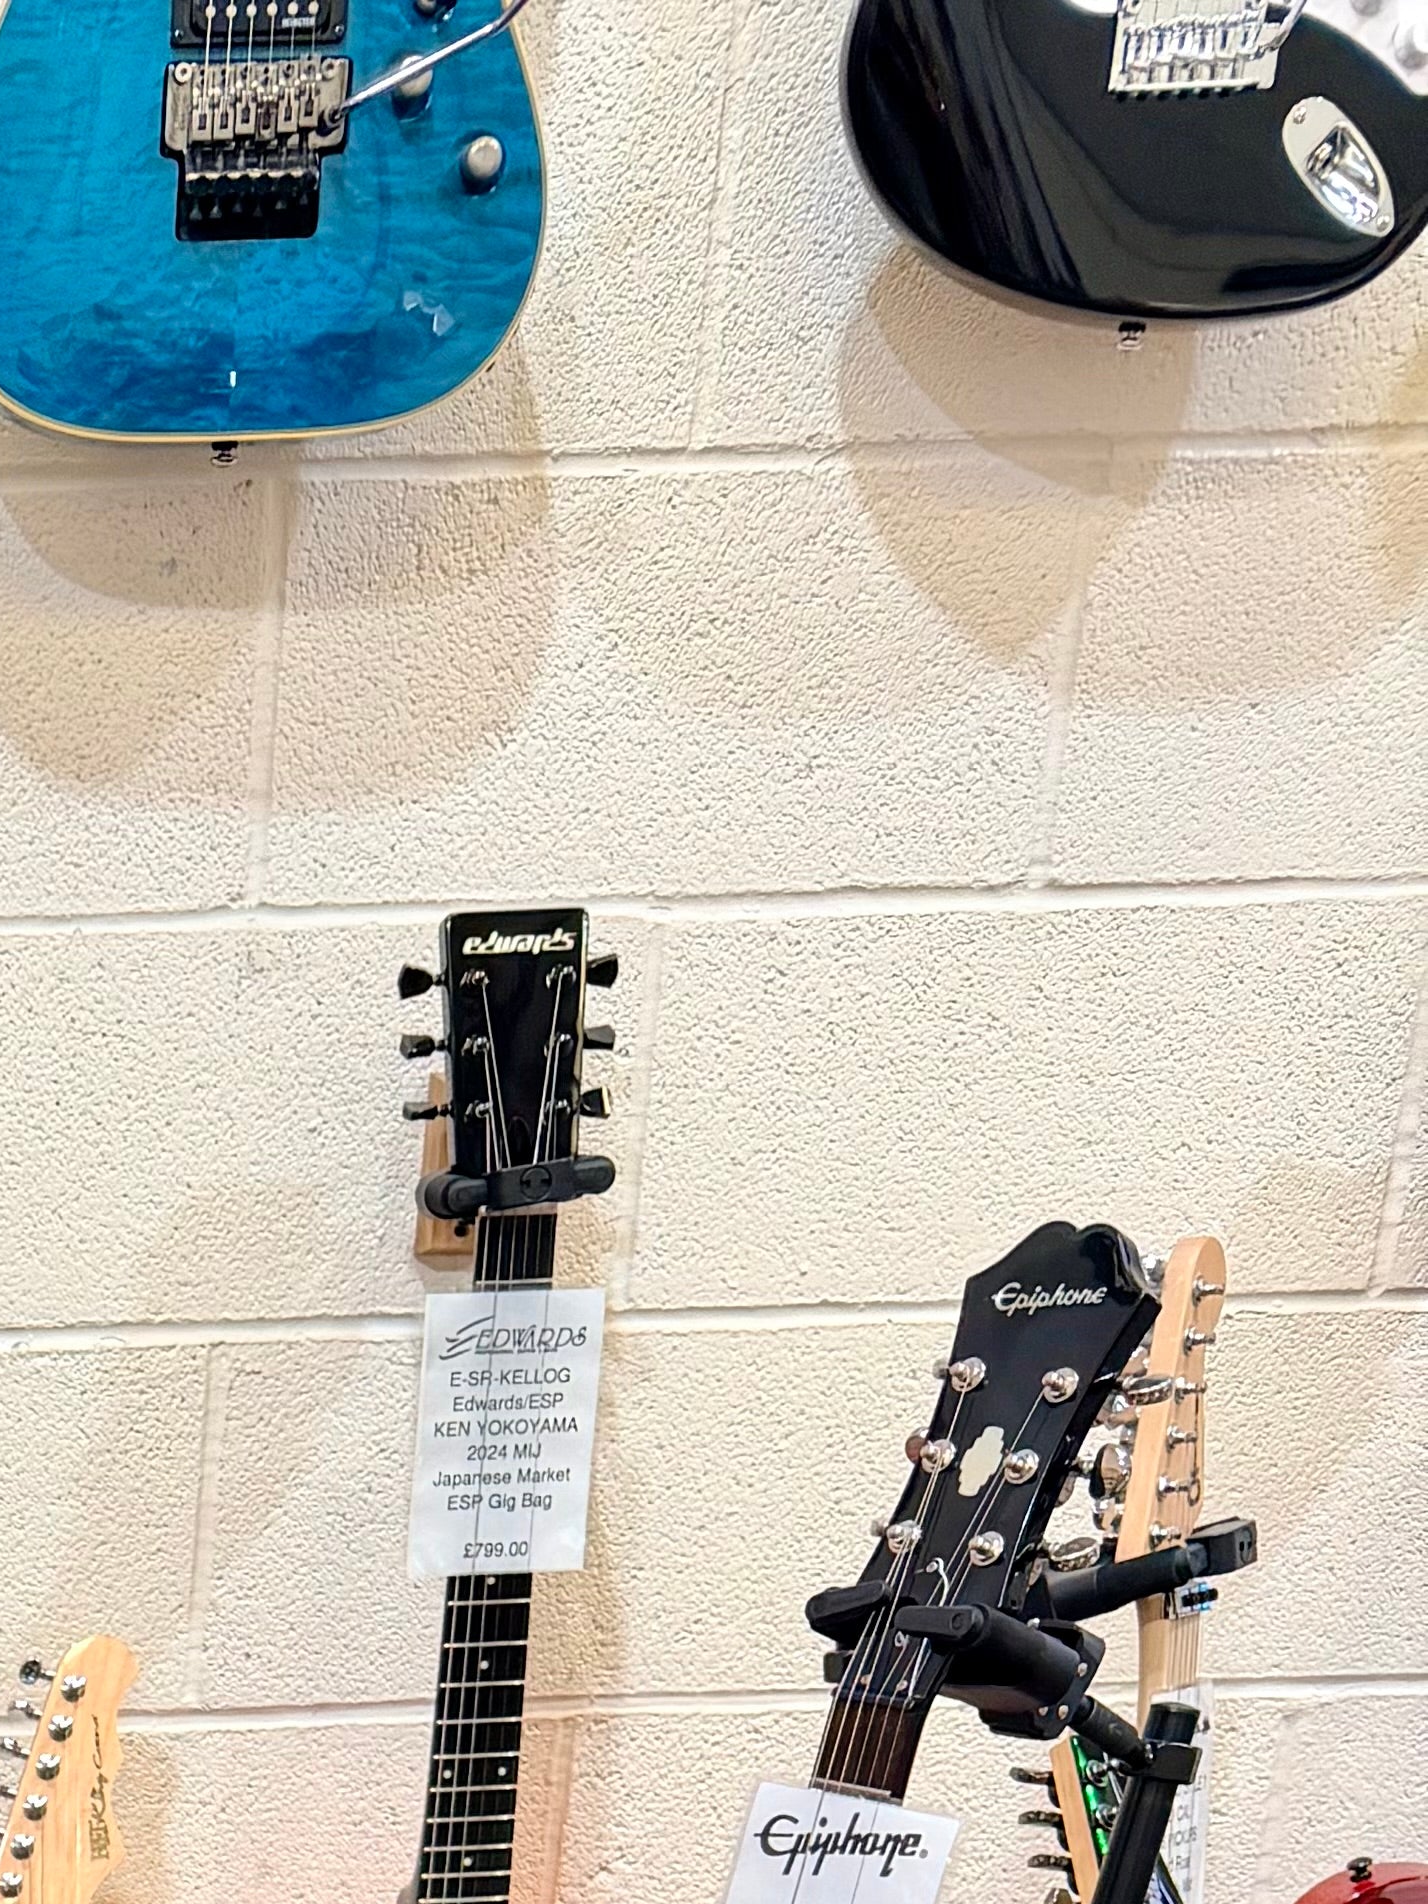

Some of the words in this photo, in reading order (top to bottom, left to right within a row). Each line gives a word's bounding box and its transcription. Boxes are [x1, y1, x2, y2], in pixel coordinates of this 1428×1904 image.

[992, 1281, 1108, 1319] Epiphone
[450, 1368, 571, 1387] E-SR-KELLOG
[452, 1392, 564, 1412] Edwards/ESP
[434, 1421, 470, 1437] KEN
[477, 1418, 578, 1436] YOKOYAMA
[466, 1446, 507, 1461] 2024
[512, 1442, 542, 1459] MIJ
[432, 1471, 512, 1487] Japanese
[516, 1468, 570, 1484] Market
[447, 1495, 483, 1510] ESP
[488, 1494, 516, 1512] Gig
[522, 1493, 552, 1510] Bag
[463, 1542, 528, 1558] £799.00
[753, 1812, 922, 1878] Epiphone
